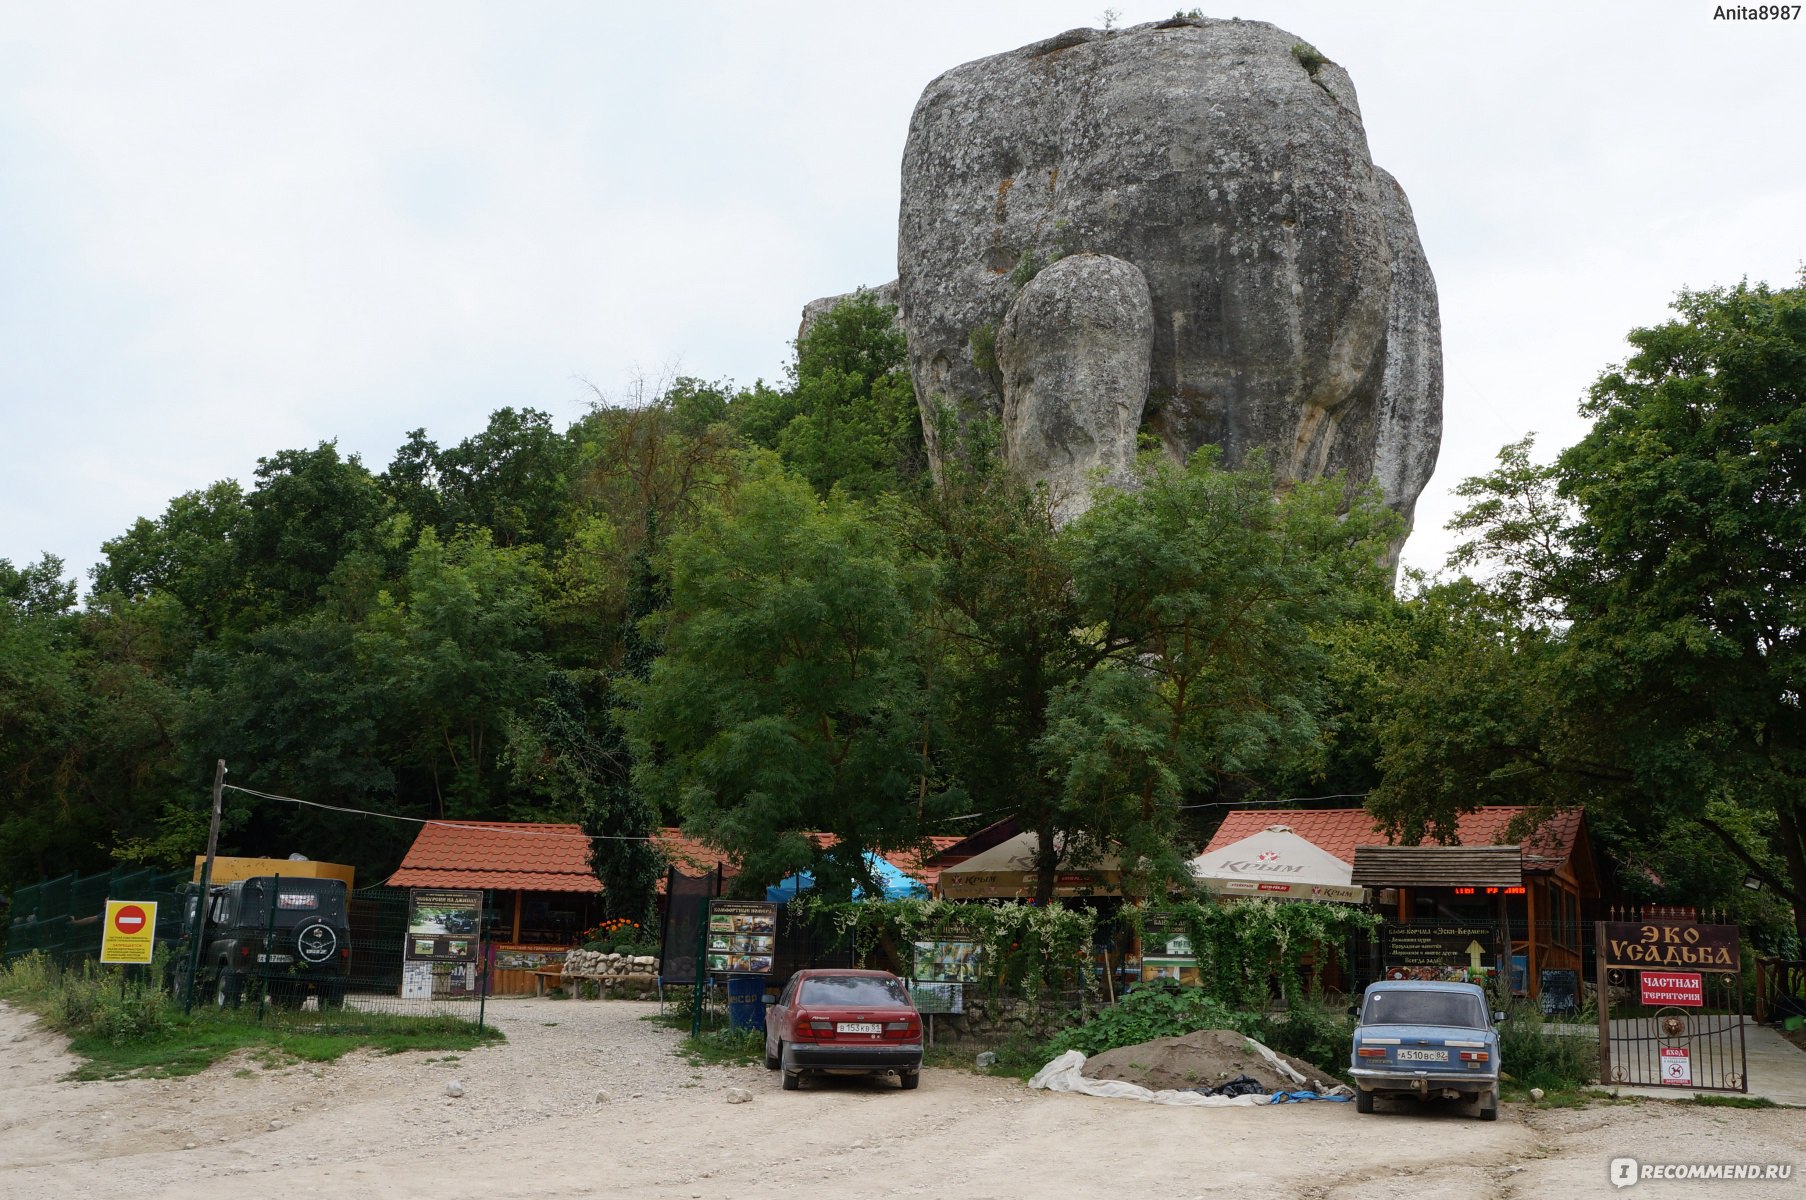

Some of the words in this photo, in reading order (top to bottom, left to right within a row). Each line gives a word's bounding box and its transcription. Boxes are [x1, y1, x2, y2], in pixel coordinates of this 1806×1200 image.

[1641, 925, 1700, 944] ЭКО
[1610, 940, 1734, 966] УСАДЬБА
[1643, 977, 1700, 989] ЧАСТНАЯ
[1643, 991, 1701, 1001] ТЕРРИТОРИЯ
